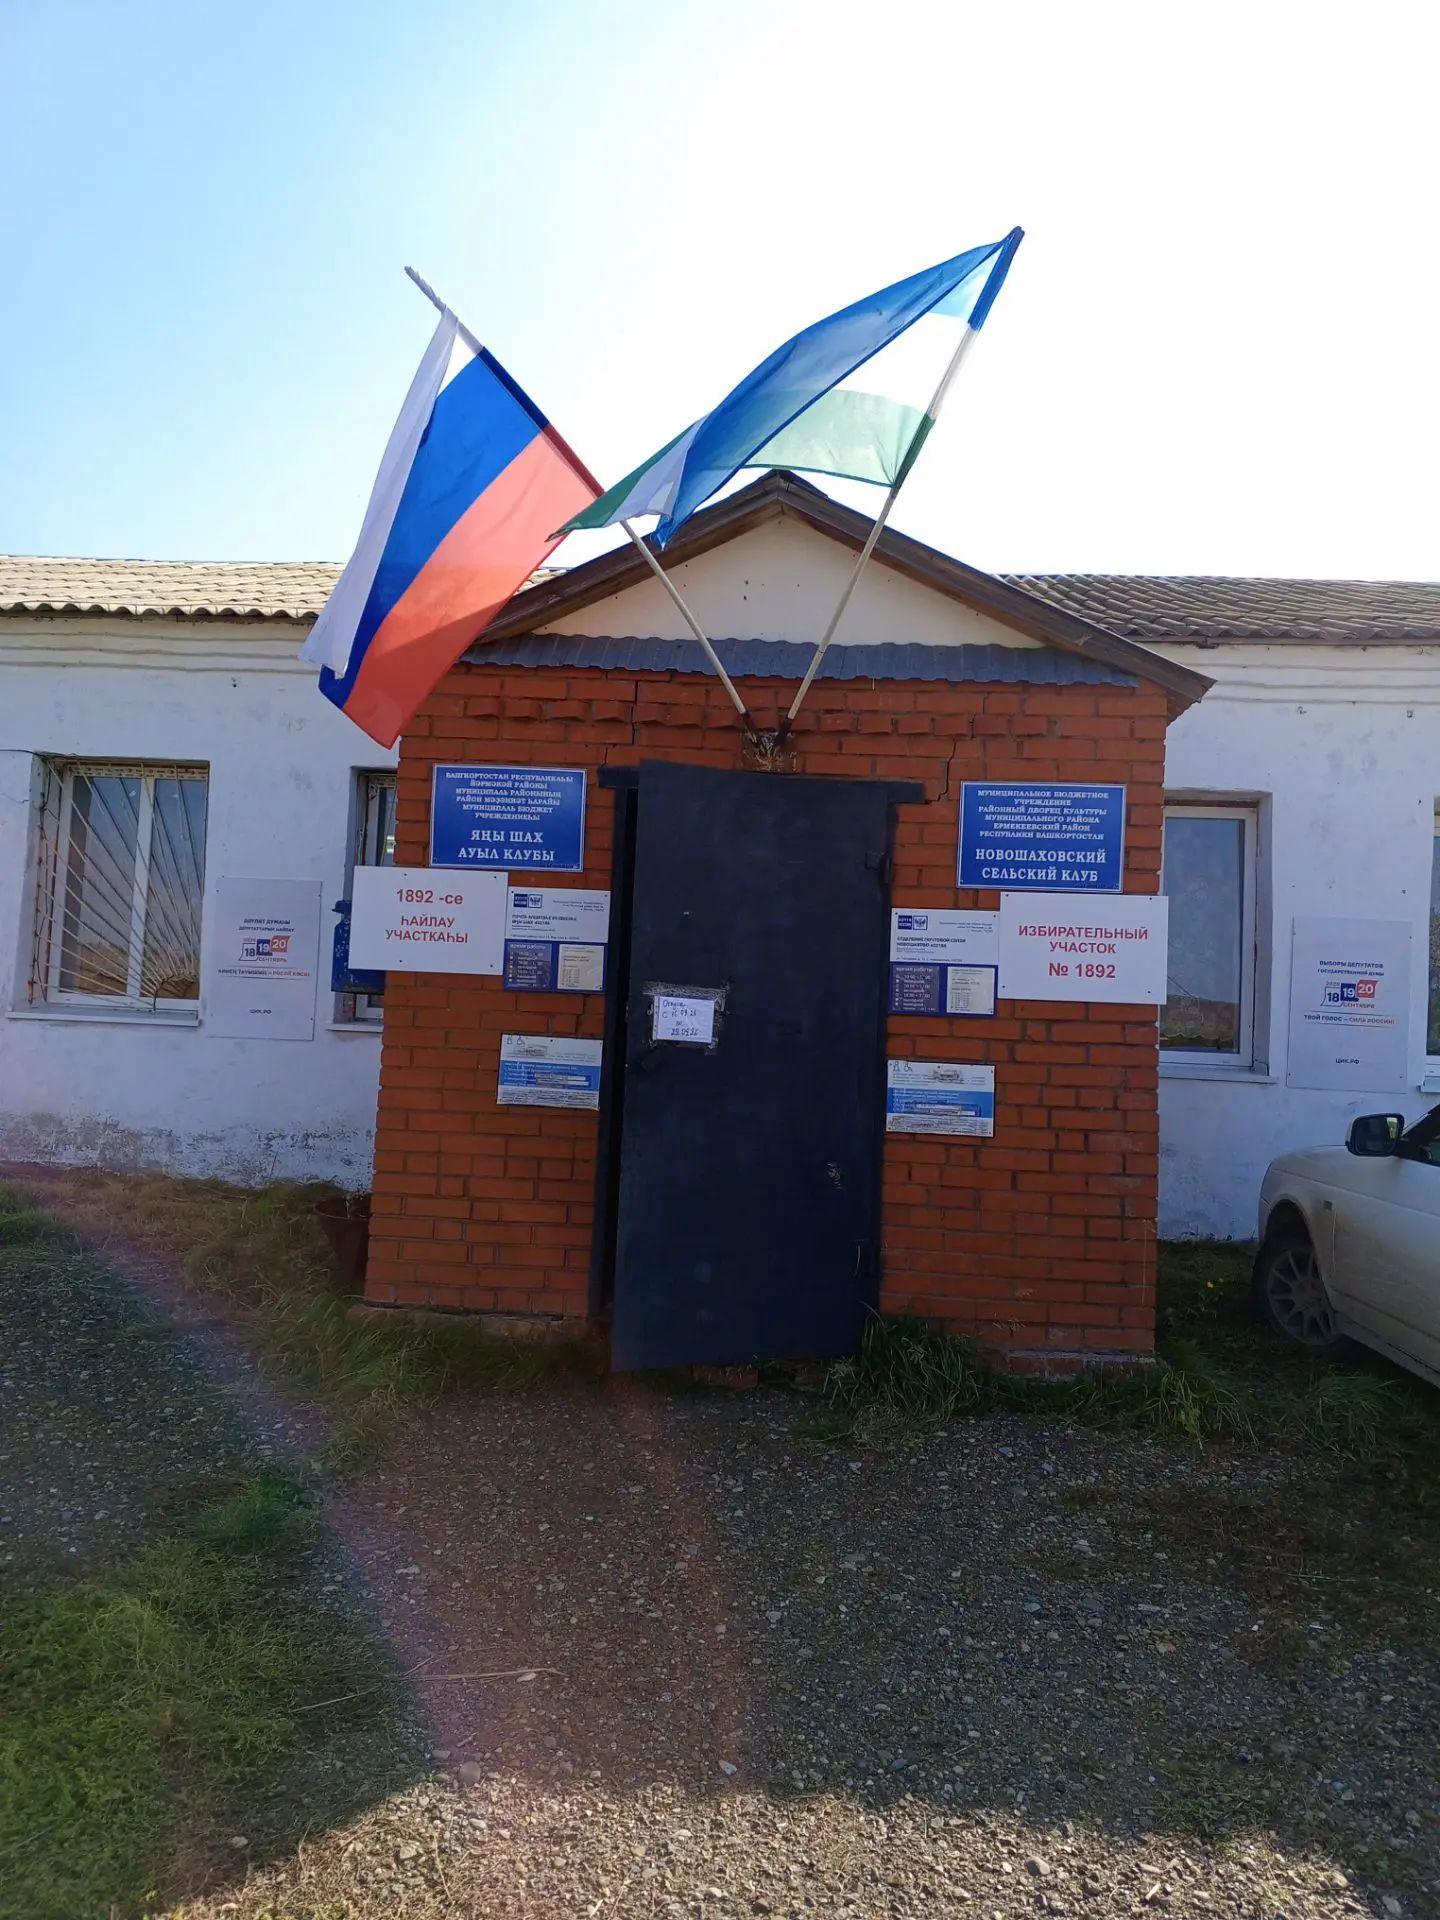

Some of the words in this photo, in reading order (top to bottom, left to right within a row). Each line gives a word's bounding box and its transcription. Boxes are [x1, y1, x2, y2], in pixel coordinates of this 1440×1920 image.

[514, 780, 547, 789] РАЙОНЫ
[456, 788, 508, 796] МУНИЦИПАЛЬ
[978, 789, 1051, 798] МУНИЦИПАЛЬНОЕ
[1054, 791, 1109, 799] БЮДЖЕТНОЕ
[1014, 798, 1071, 806] УЧРЕЖДЕНИЕ
[462, 804, 516, 812] МУНИЦИПАЛЬ
[518, 806, 553, 814] БЮДЖЕТ
[978, 805, 1025, 813] РАЙОННЫЙ
[1027, 806, 1062, 815] ДВОРЕЦ
[1063, 808, 1107, 816] КУЛЬТУРЫ
[984, 814, 1064, 823] МУНИЦИПАЛЬНОГО
[1066, 814, 1099, 824] РАЙОНА
[993, 822, 1060, 831] ЕРМЕКЕЕВСКИЙ
[1062, 823, 1090, 832] РАЙОН
[470, 830, 505, 842] ЯҢЫ
[509, 831, 544, 843] ШАХ
[1036, 832, 1104, 840] БАШКОРТОСТАН
[458, 847, 499, 859] АУЫЛ
[503, 849, 554, 861] КЛУБЫ
[976, 848, 1106, 863] НОВОШАХОВСКИЙ
[982, 866, 1056, 880] СЕЛЬСКИЙ
[1061, 869, 1098, 882] КЛУБ
[396, 889, 434, 903] 1892
[438, 893, 463, 905] -се
[400, 914, 455, 927] ҺАЙЛАУ
[386, 929, 468, 943] УЧАСТКАҺЫ
[1018, 925, 1148, 940] ИЗБИРАТЕЛЬНЫЙ
[245, 948, 256, 957] 18
[258, 943, 270, 952] 19
[272, 939, 286, 949] 20
[1049, 941, 1116, 954] УЧАСТОК
[1048, 962, 1069, 976] №
[1075, 963, 1116, 978] 1892
[1327, 992, 1340, 1002] 18
[1342, 987, 1355, 998] 19
[1358, 984, 1374, 994] 20
